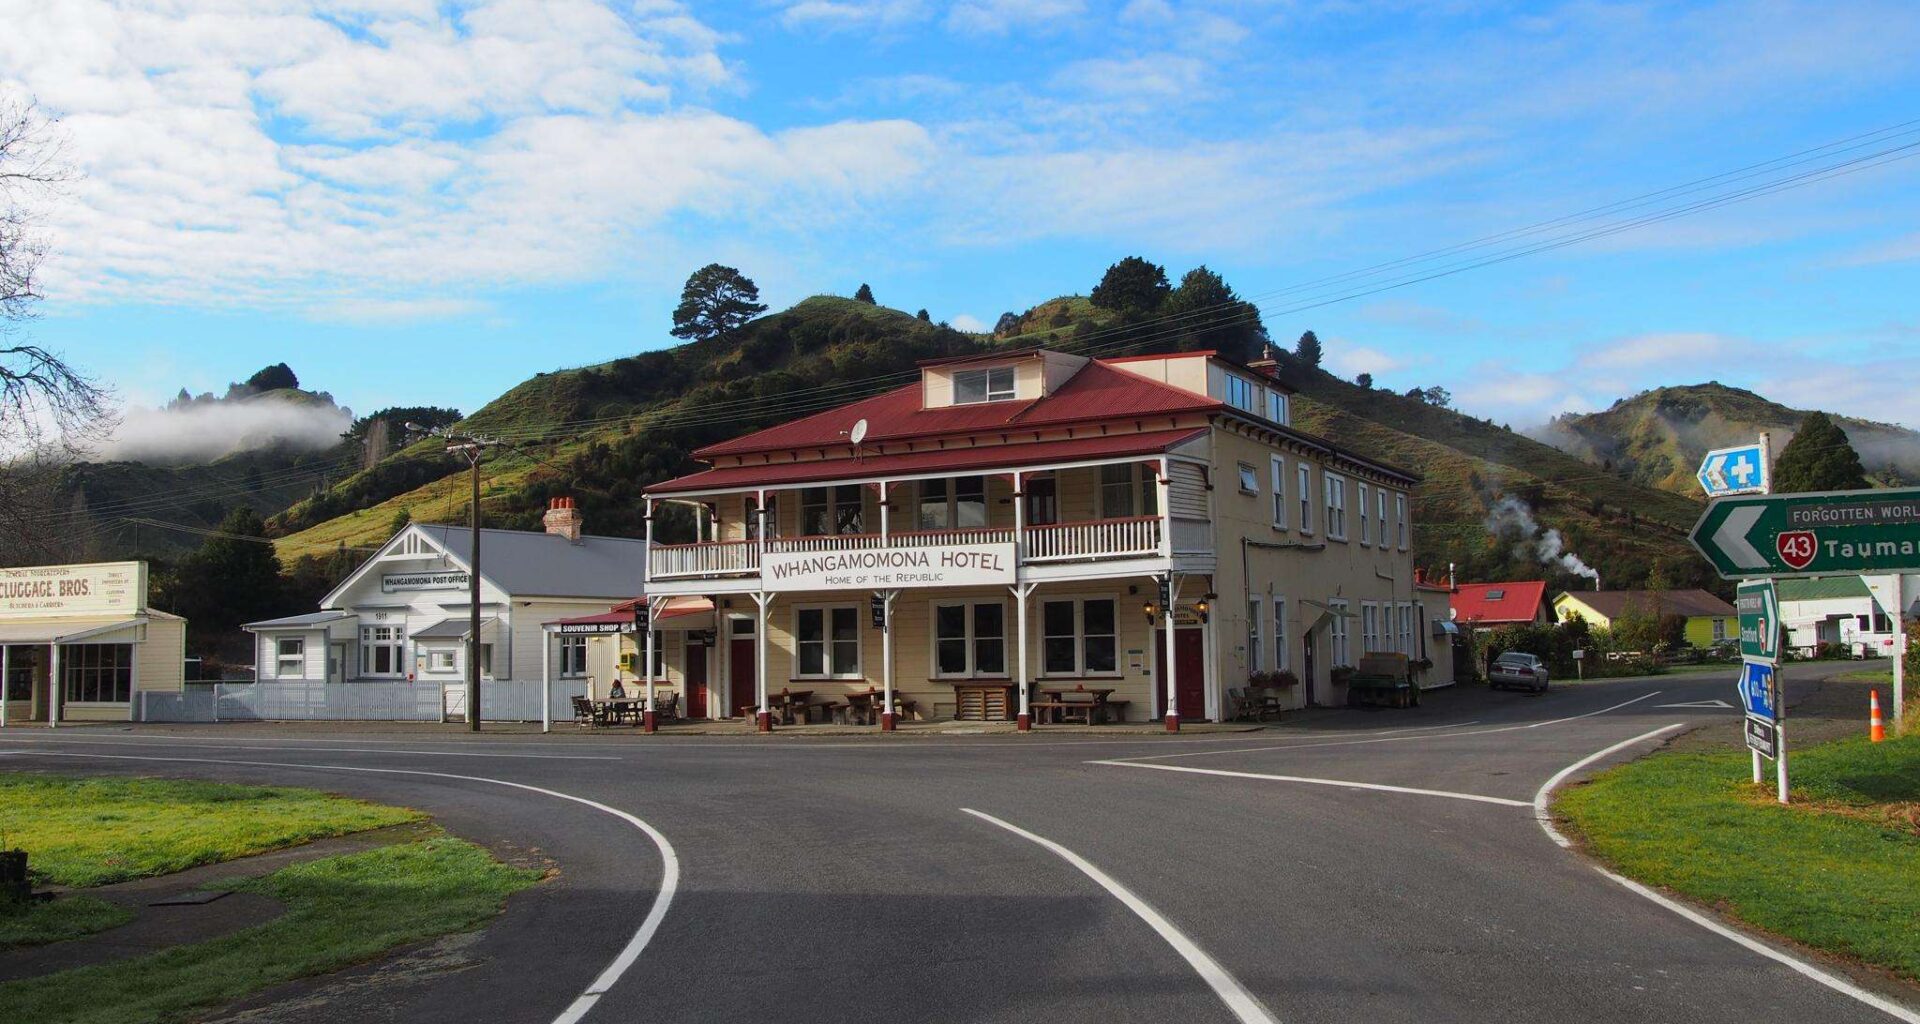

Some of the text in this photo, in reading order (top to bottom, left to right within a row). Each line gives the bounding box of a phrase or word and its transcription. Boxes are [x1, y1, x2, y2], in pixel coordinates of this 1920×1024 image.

[1793, 507, 1873, 522] FORGOTTEN
[1782, 536, 1920, 558] 43 Tauma
[772, 551, 1004, 579] WHANGAMOMONA HOTEL
[59, 578, 91, 596] BROS.
[385, 575, 467, 586] WHANGAMOMONA POST OFFICE
[562, 624, 619, 632] SOUVENIR SHOP
